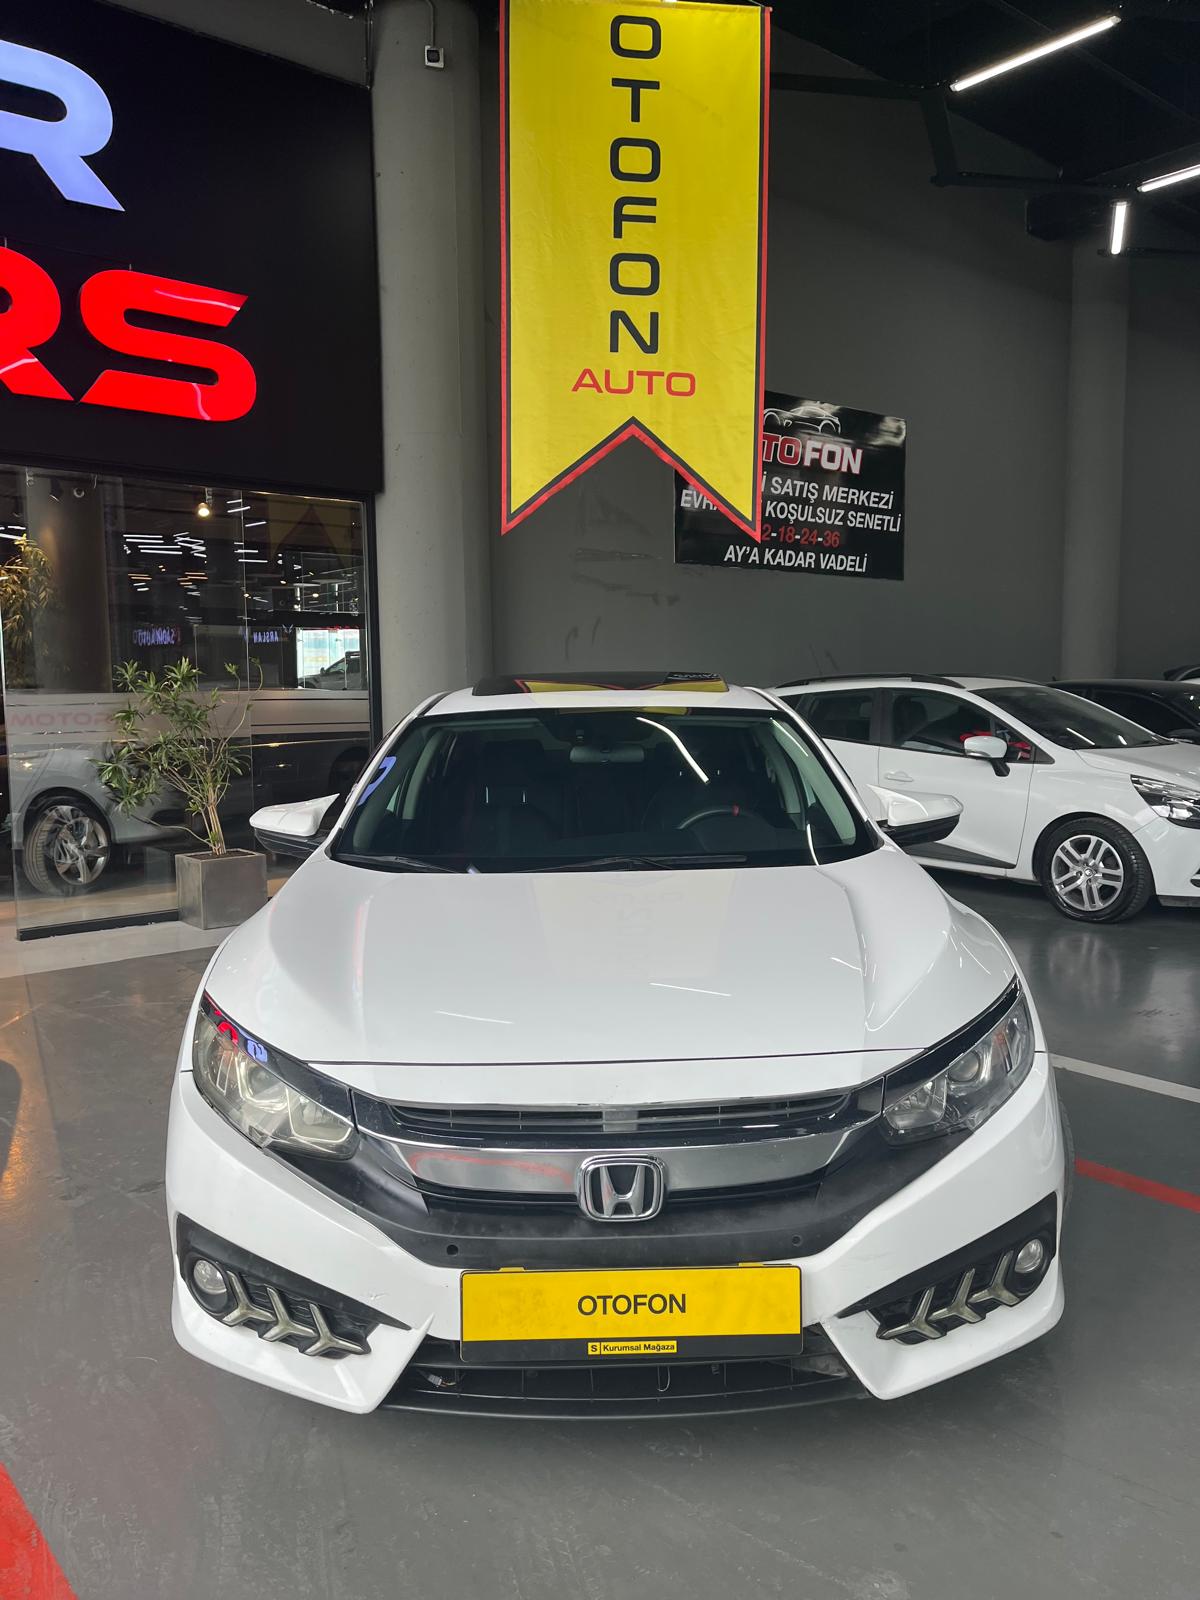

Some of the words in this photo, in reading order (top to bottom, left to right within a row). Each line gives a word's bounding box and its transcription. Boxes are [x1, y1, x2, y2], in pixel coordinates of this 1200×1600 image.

[610, 14, 662, 355] OTOFON
[571, 367, 696, 397] AUTO
[770, 476, 819, 504] SATIŞ
[822, 484, 894, 510] MERKEZİ
[765, 500, 845, 524] KOŞULSUZ
[847, 511, 902, 533] SENETLİ
[763, 548, 816, 568] KADAR
[819, 553, 868, 573] VADELİ
[577, 1293, 687, 1316] OTOFON
[603, 1343, 642, 1352] Kurumsal
[643, 1342, 675, 1352] Mağaza
